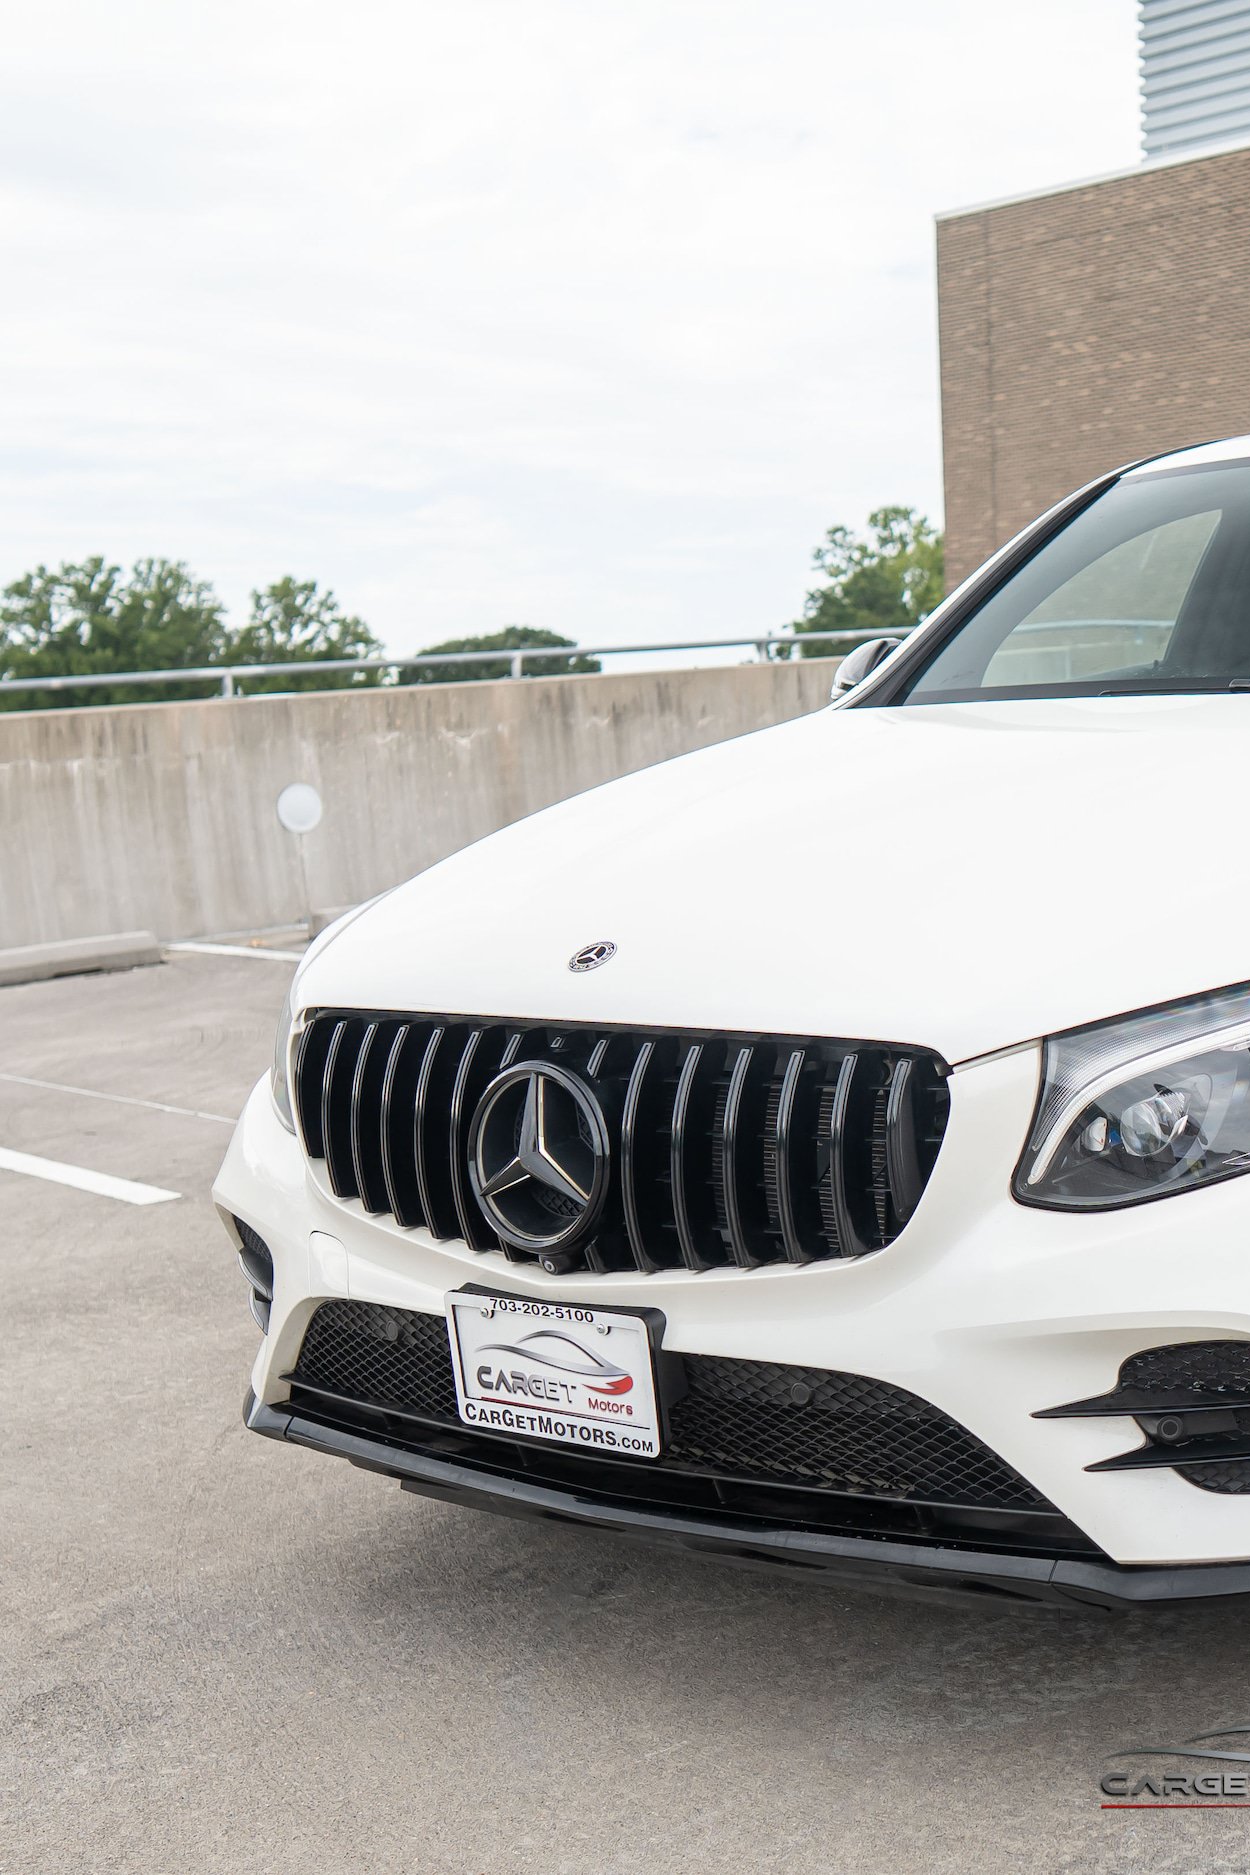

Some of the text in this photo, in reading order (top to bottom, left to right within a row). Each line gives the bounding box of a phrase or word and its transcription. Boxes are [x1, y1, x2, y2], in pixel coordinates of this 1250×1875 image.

[490, 1298, 594, 1323] 703-202-5100
[477, 1365, 634, 1416] CARGET Motors
